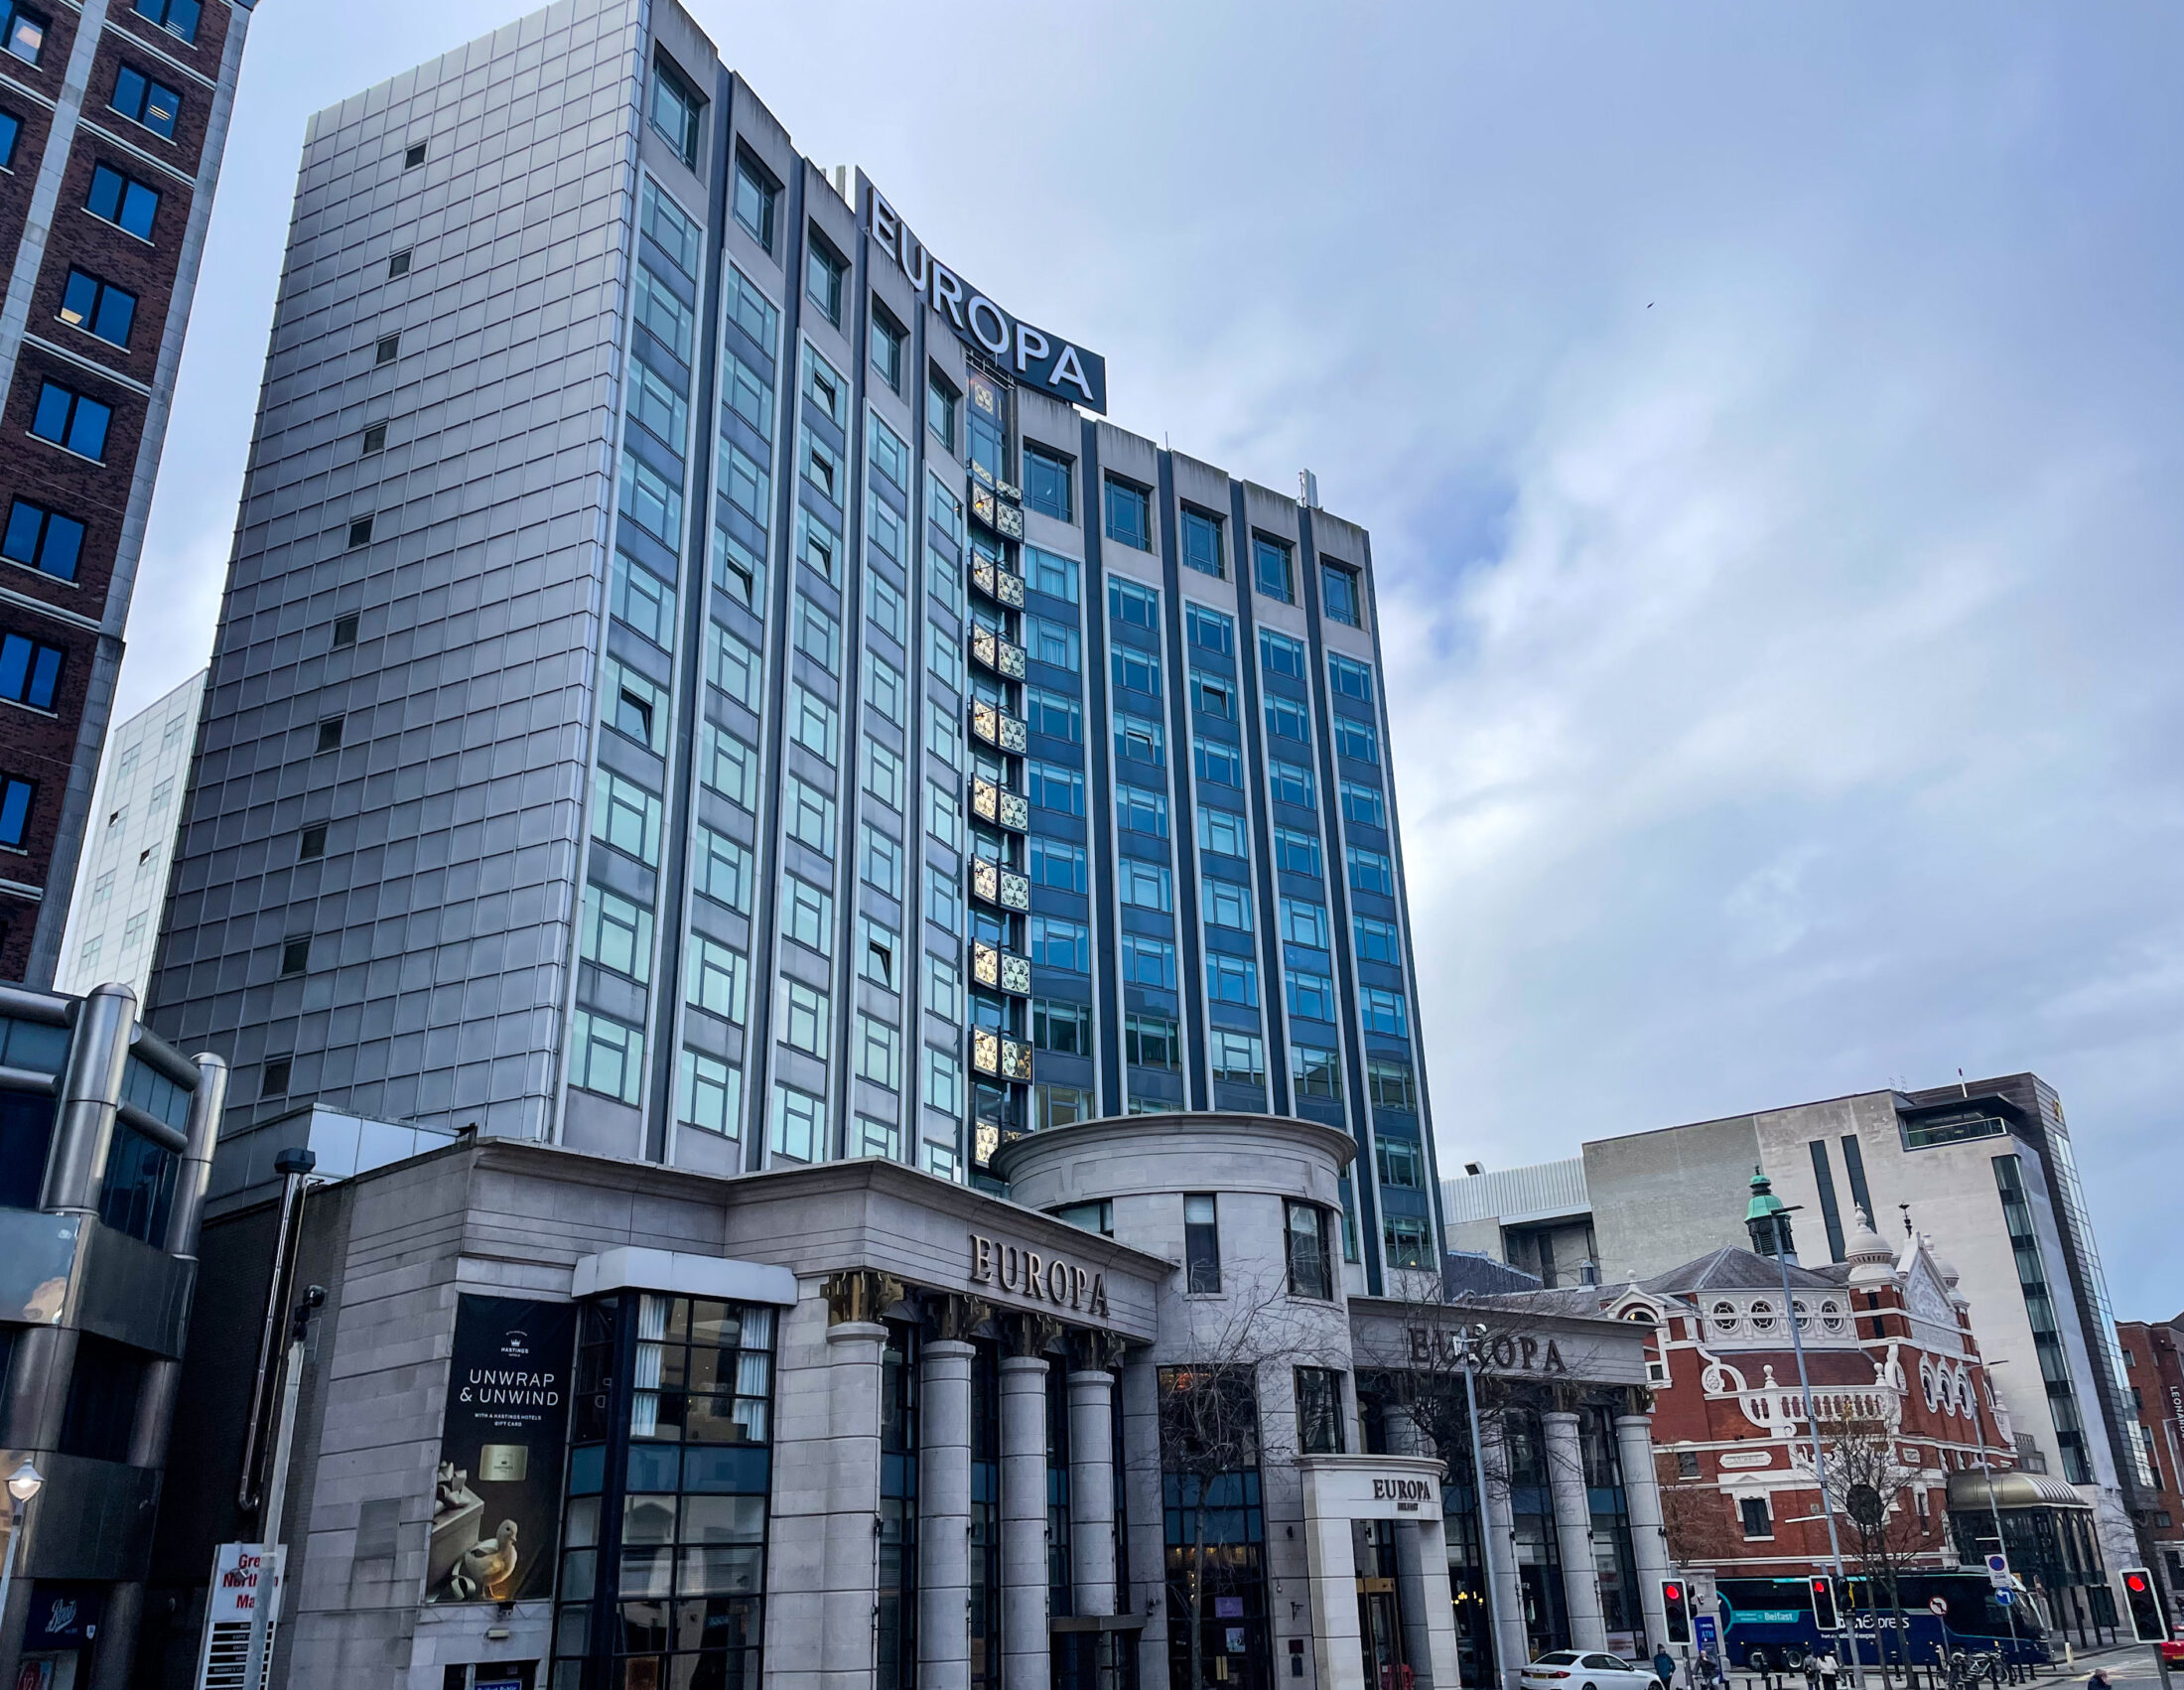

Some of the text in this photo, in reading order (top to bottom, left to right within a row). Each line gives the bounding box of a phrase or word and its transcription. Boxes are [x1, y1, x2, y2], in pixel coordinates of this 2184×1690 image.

[870, 187, 1094, 400] EUROPA
[970, 1234, 1110, 1317] EUROPA
[470, 1369, 554, 1387] UNWRAP
[460, 1387, 558, 1405] & UNWIND
[1372, 1479, 1431, 1500] EUROPA
[239, 1554, 260, 1569] Gre
[1764, 1612, 1794, 1621] Belfast
